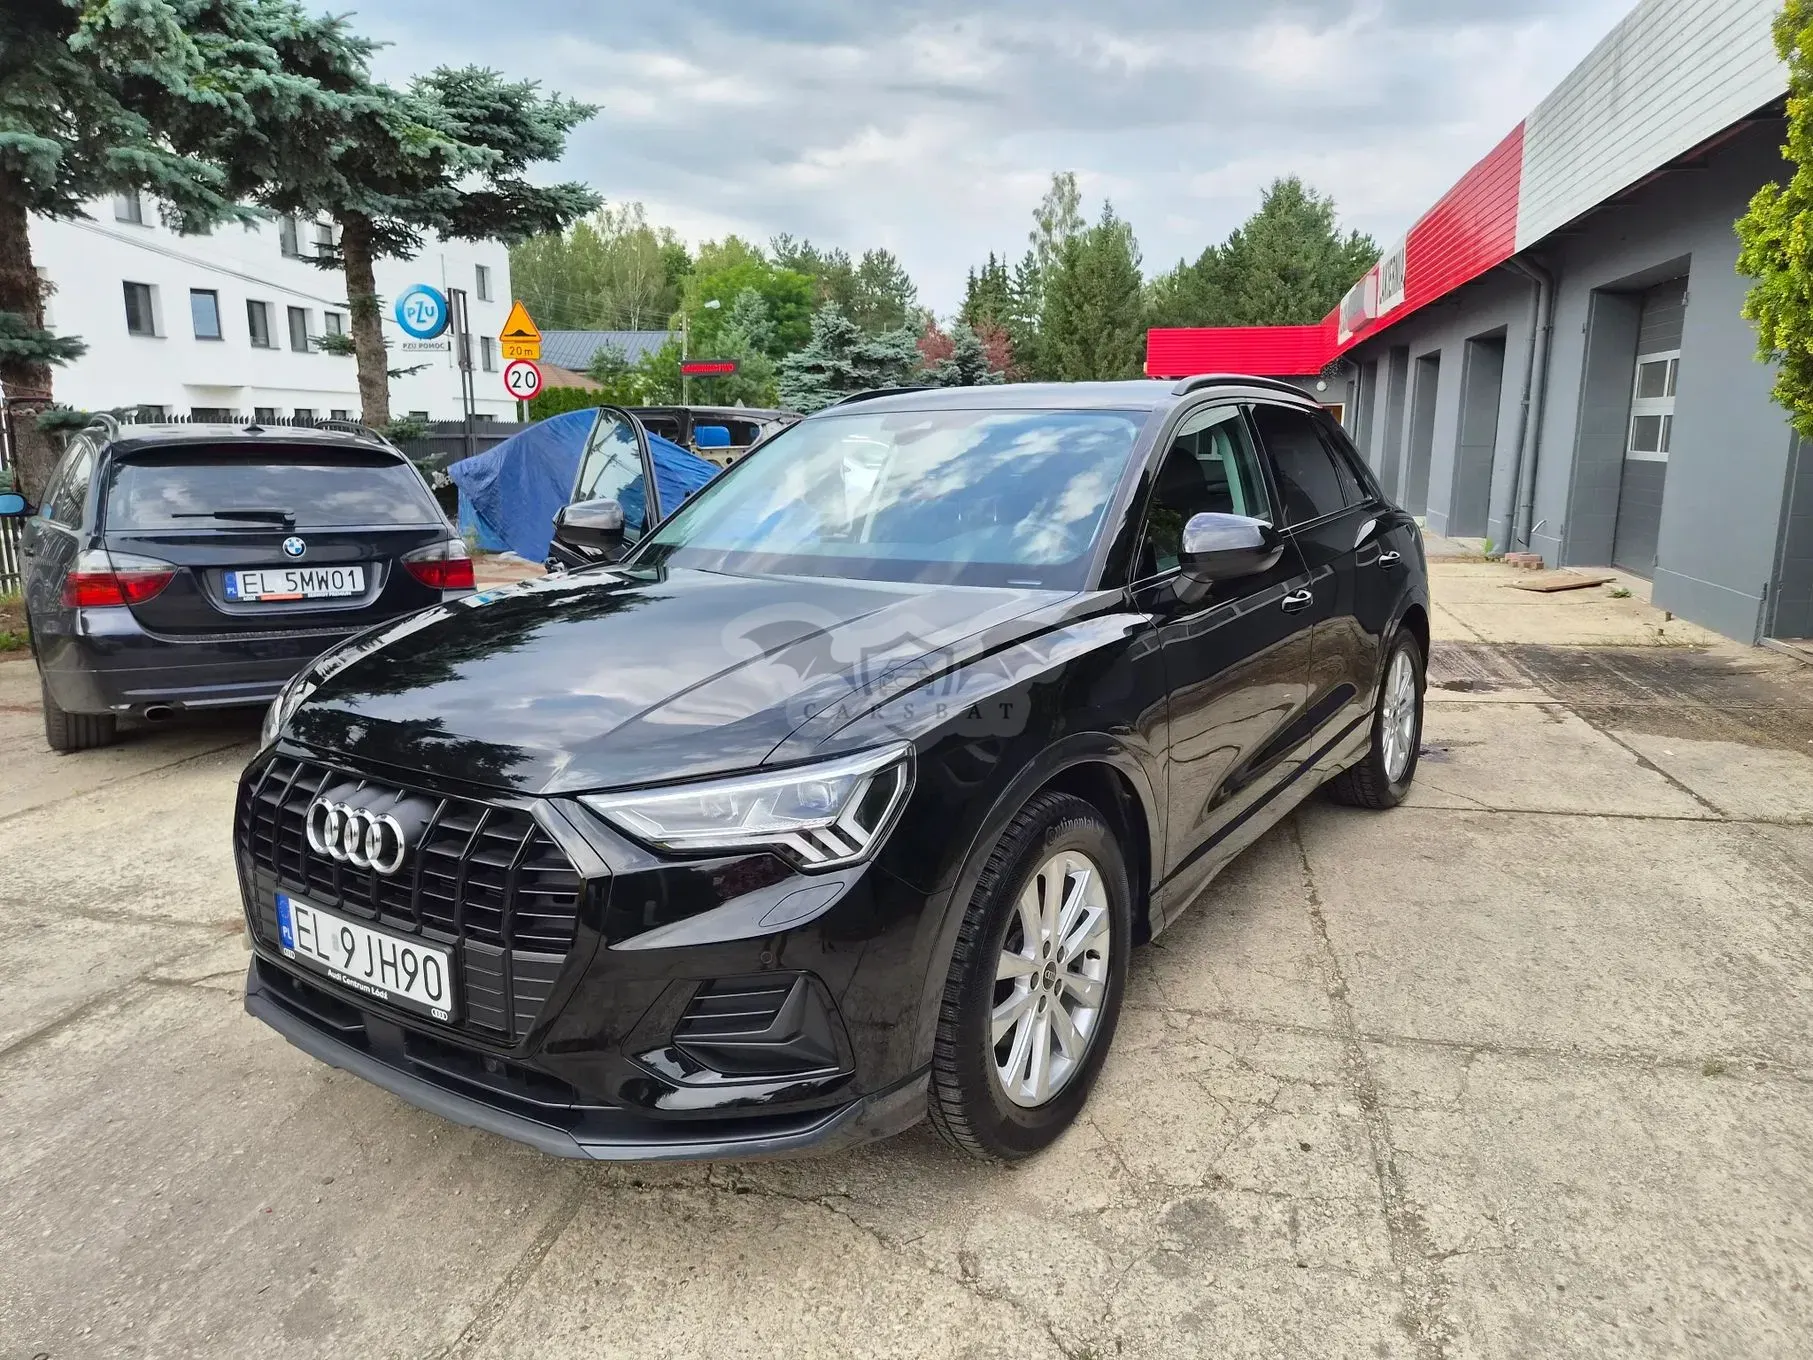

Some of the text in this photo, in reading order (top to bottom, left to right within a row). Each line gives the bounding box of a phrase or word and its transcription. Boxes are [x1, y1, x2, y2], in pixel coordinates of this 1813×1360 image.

[407, 301, 435, 324] PZU
[512, 371, 536, 388] 20
[242, 570, 357, 594] EL 5MW01
[282, 926, 293, 940] PL
[295, 905, 443, 1002] EL 9JH90
[327, 969, 389, 1000] Audi Centrum Łódź
